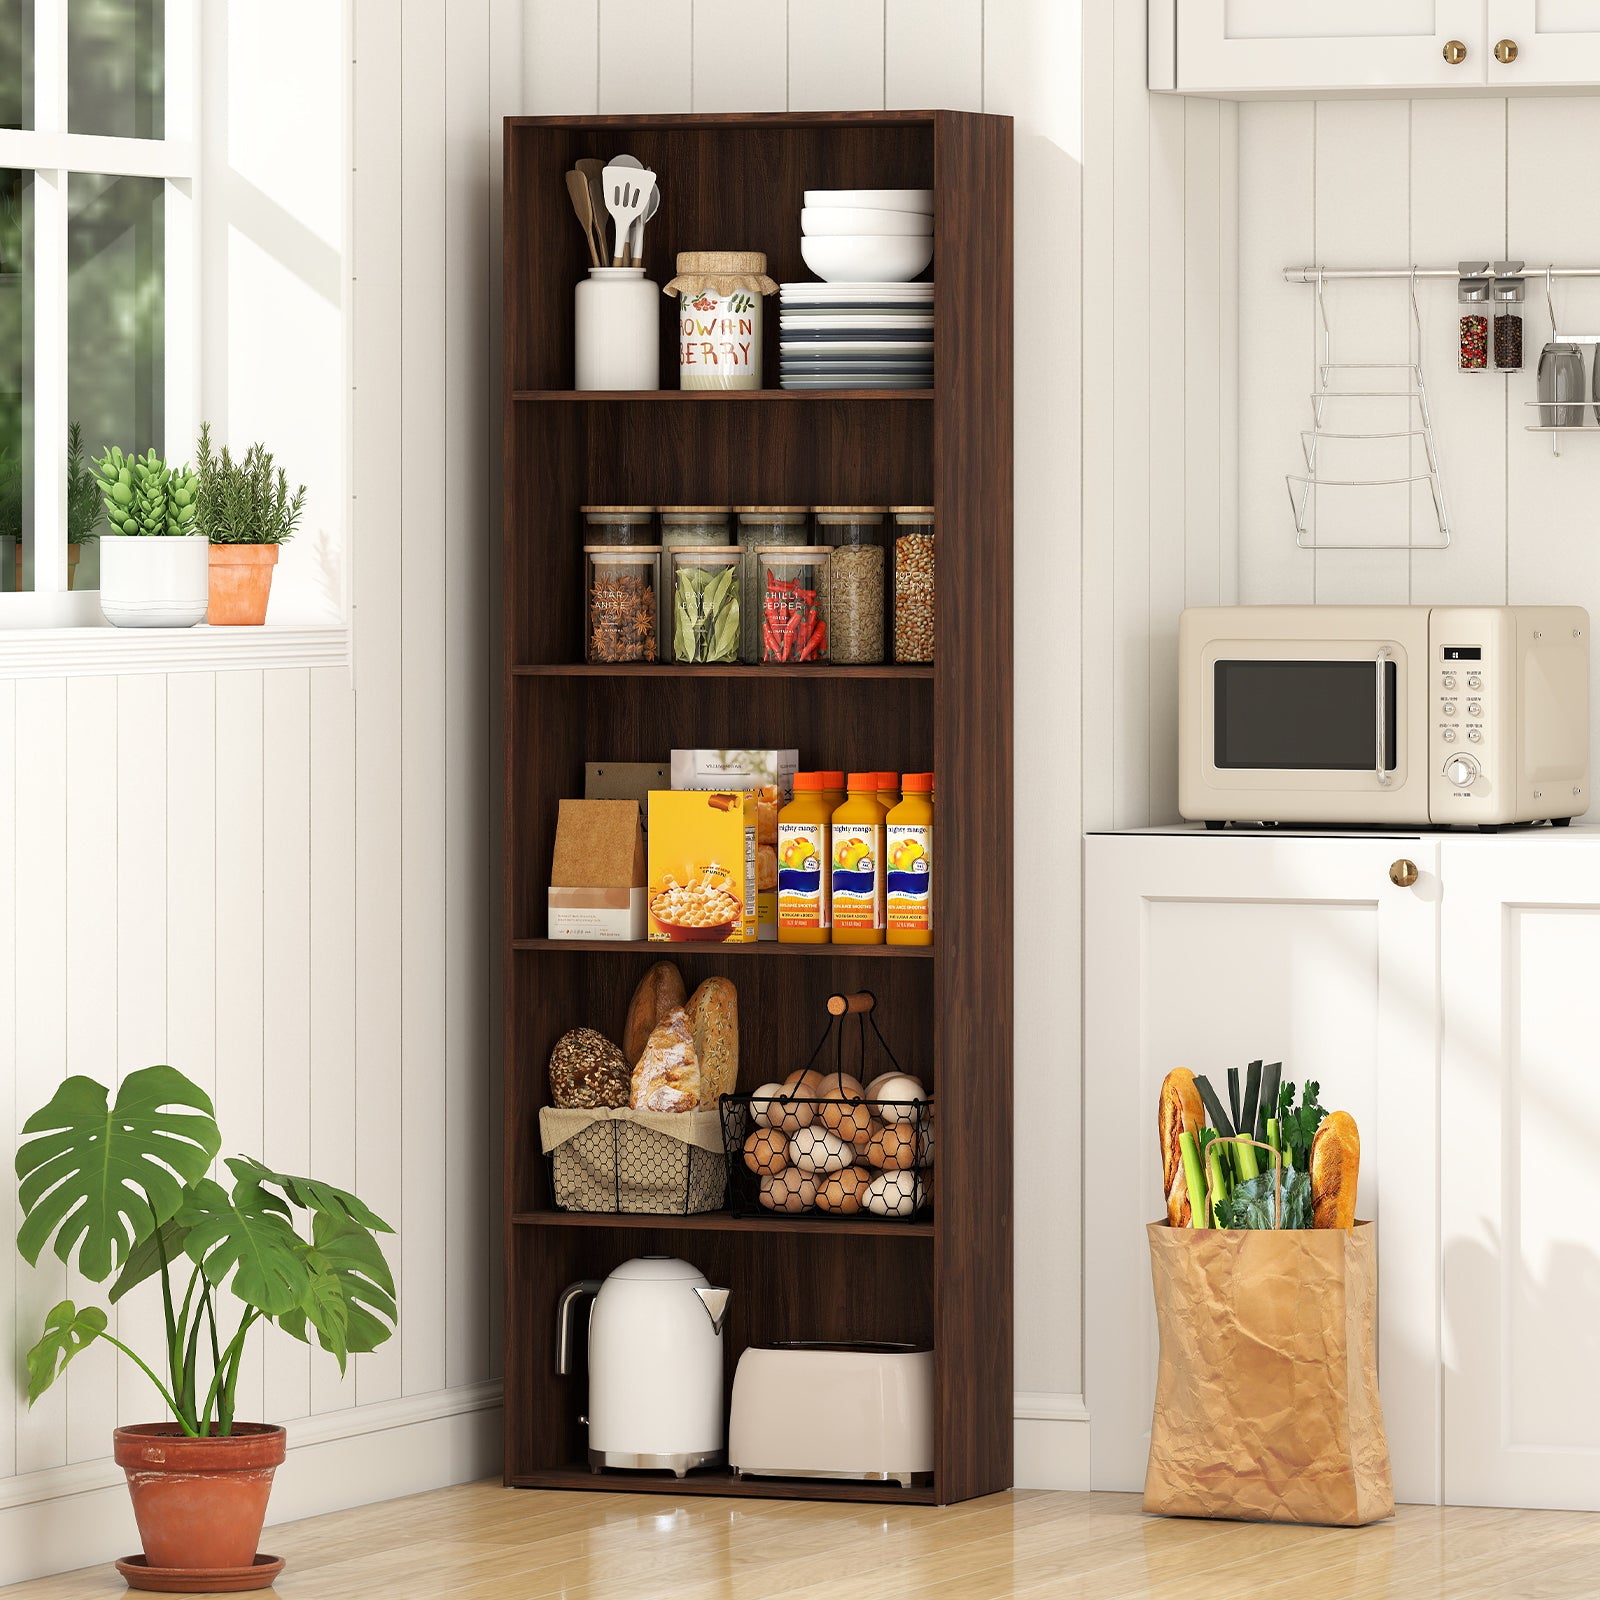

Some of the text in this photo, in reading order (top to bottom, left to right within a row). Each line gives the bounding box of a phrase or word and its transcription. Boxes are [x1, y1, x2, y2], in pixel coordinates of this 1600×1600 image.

[597, 591, 623, 599] STAR
[685, 591, 705, 599] BAY
[765, 591, 799, 600] CHILLI
[595, 601, 626, 609] ANISE
[763, 602, 802, 610] PEPPER
